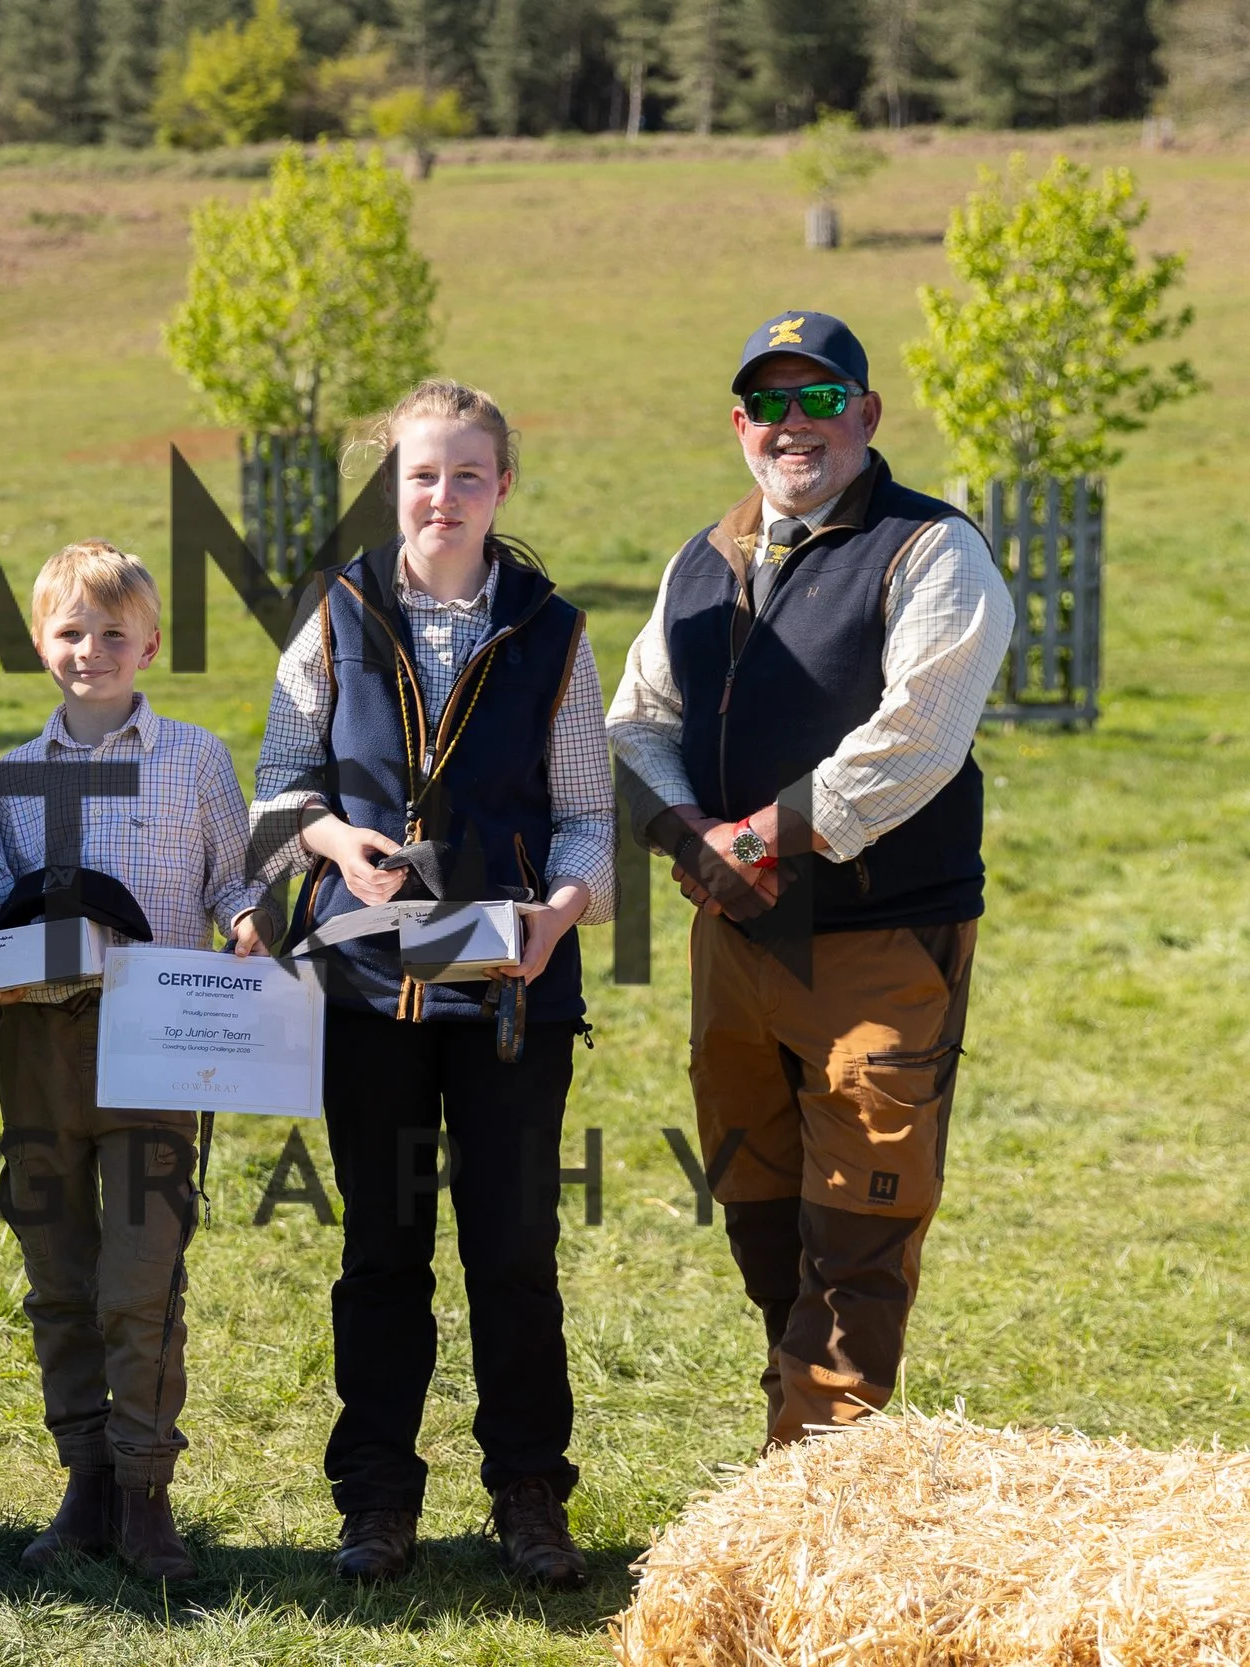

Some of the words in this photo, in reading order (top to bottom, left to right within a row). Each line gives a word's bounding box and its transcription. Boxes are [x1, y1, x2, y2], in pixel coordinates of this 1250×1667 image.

[158, 972, 262, 992] CERTIFICATE
[194, 991, 235, 999] achievement
[182, 1009, 203, 1018] Proudly
[203, 1011, 231, 1019] presented
[164, 1026, 183, 1037] Top
[185, 1027, 219, 1039] Junior
[222, 1029, 251, 1041] Team
[162, 1043, 186, 1051] Cowdray
[187, 1044, 208, 1052] Gundog
[209, 1045, 235, 1053] Challenge
[172, 1081, 240, 1094] COWDRAY
